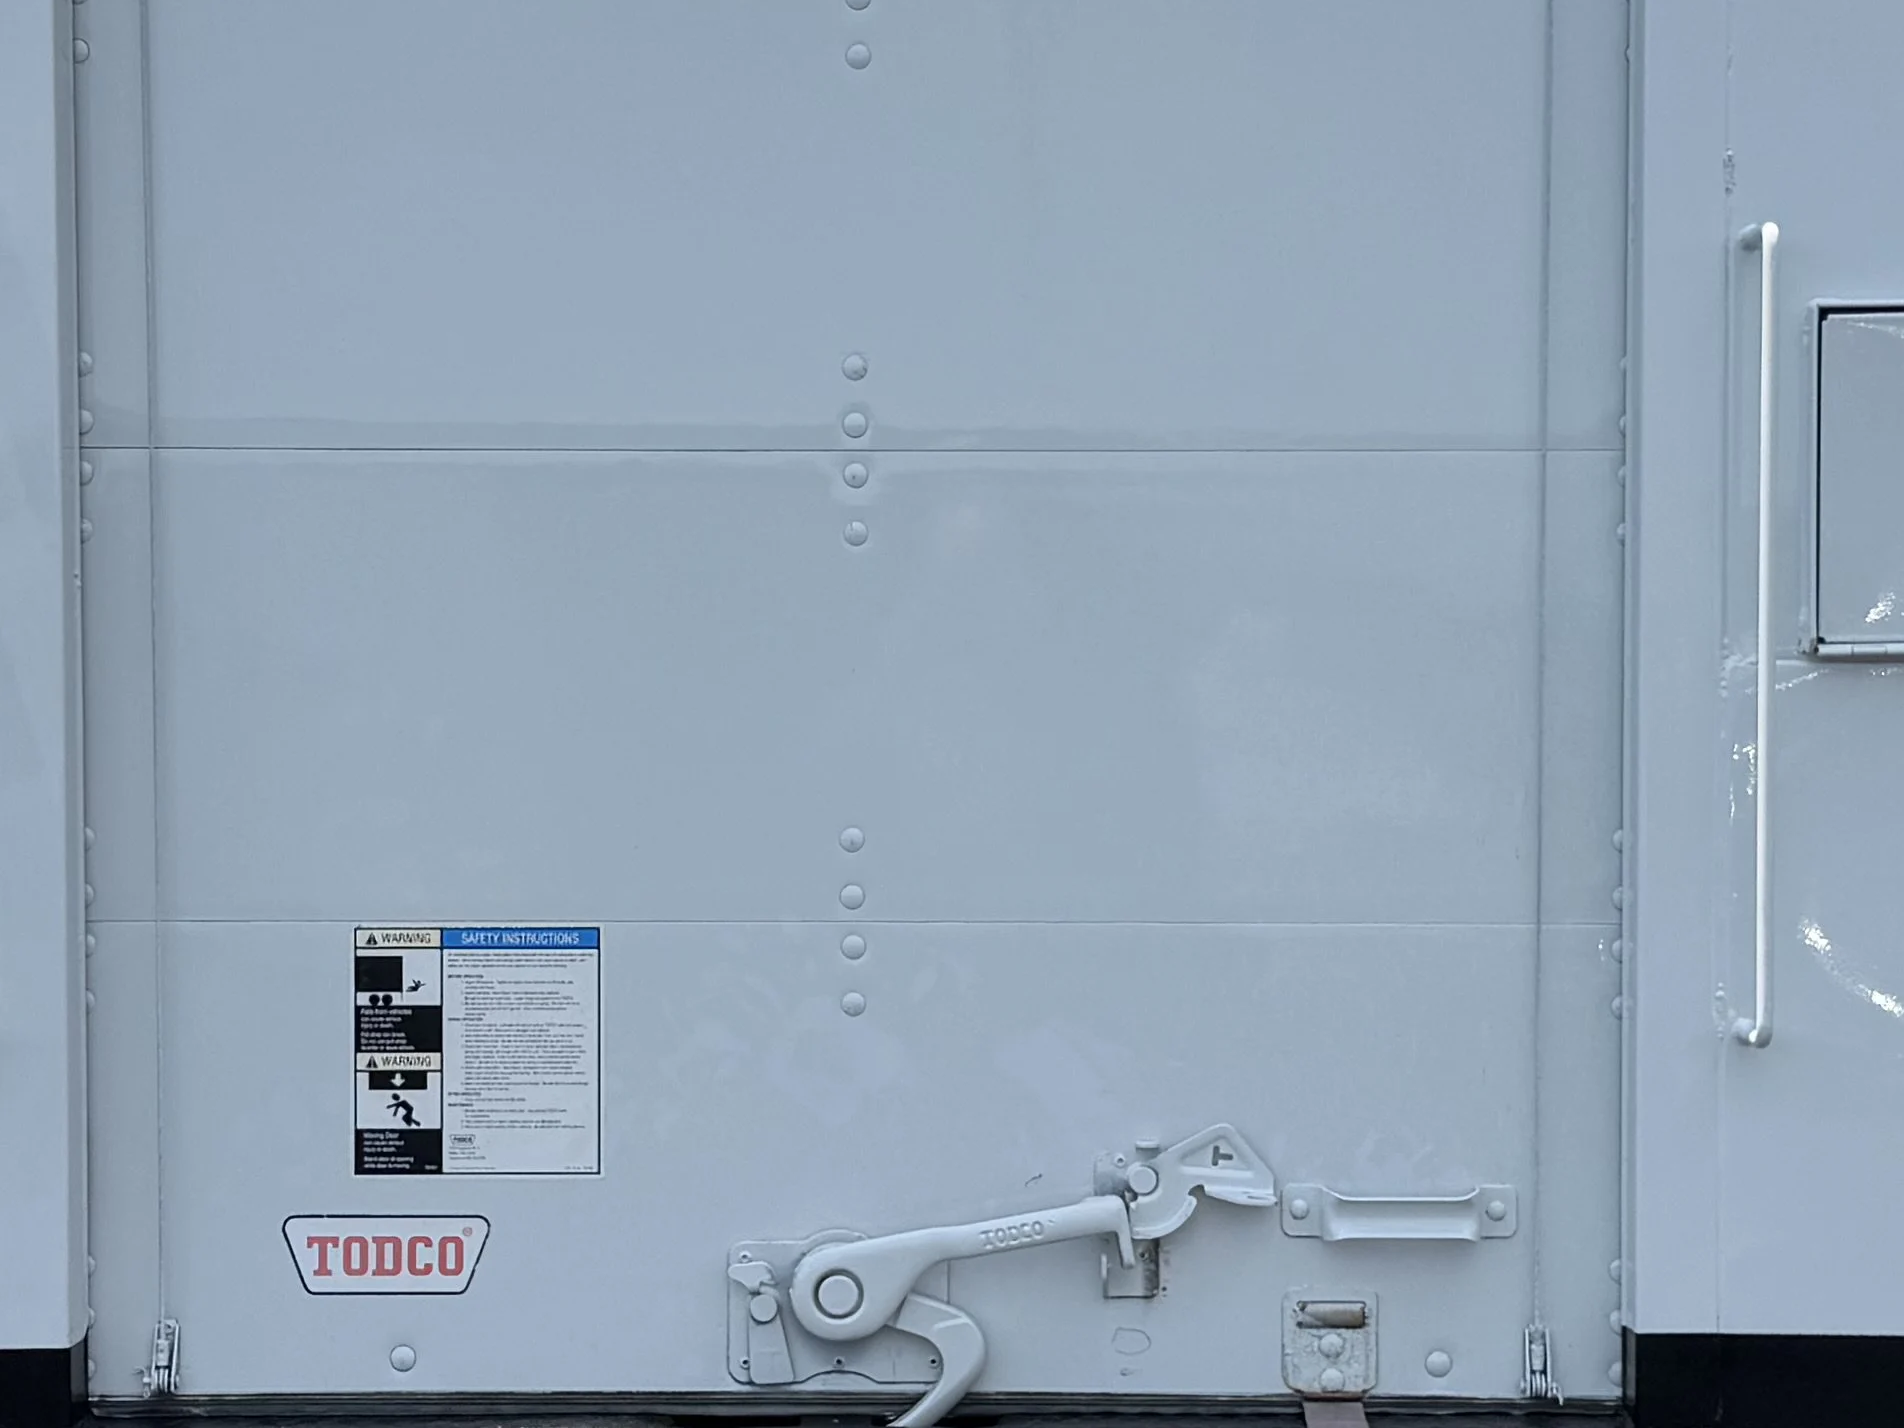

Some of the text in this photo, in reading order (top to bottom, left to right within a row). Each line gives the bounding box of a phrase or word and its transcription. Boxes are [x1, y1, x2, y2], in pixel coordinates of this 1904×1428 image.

[381, 932, 431, 944] WARNING
[461, 931, 580, 945] SAFETY INSTRUCTIONS
[381, 1055, 432, 1068] WARNING
[978, 1219, 1045, 1250] TODCO
[307, 1235, 464, 1277] TODCO
